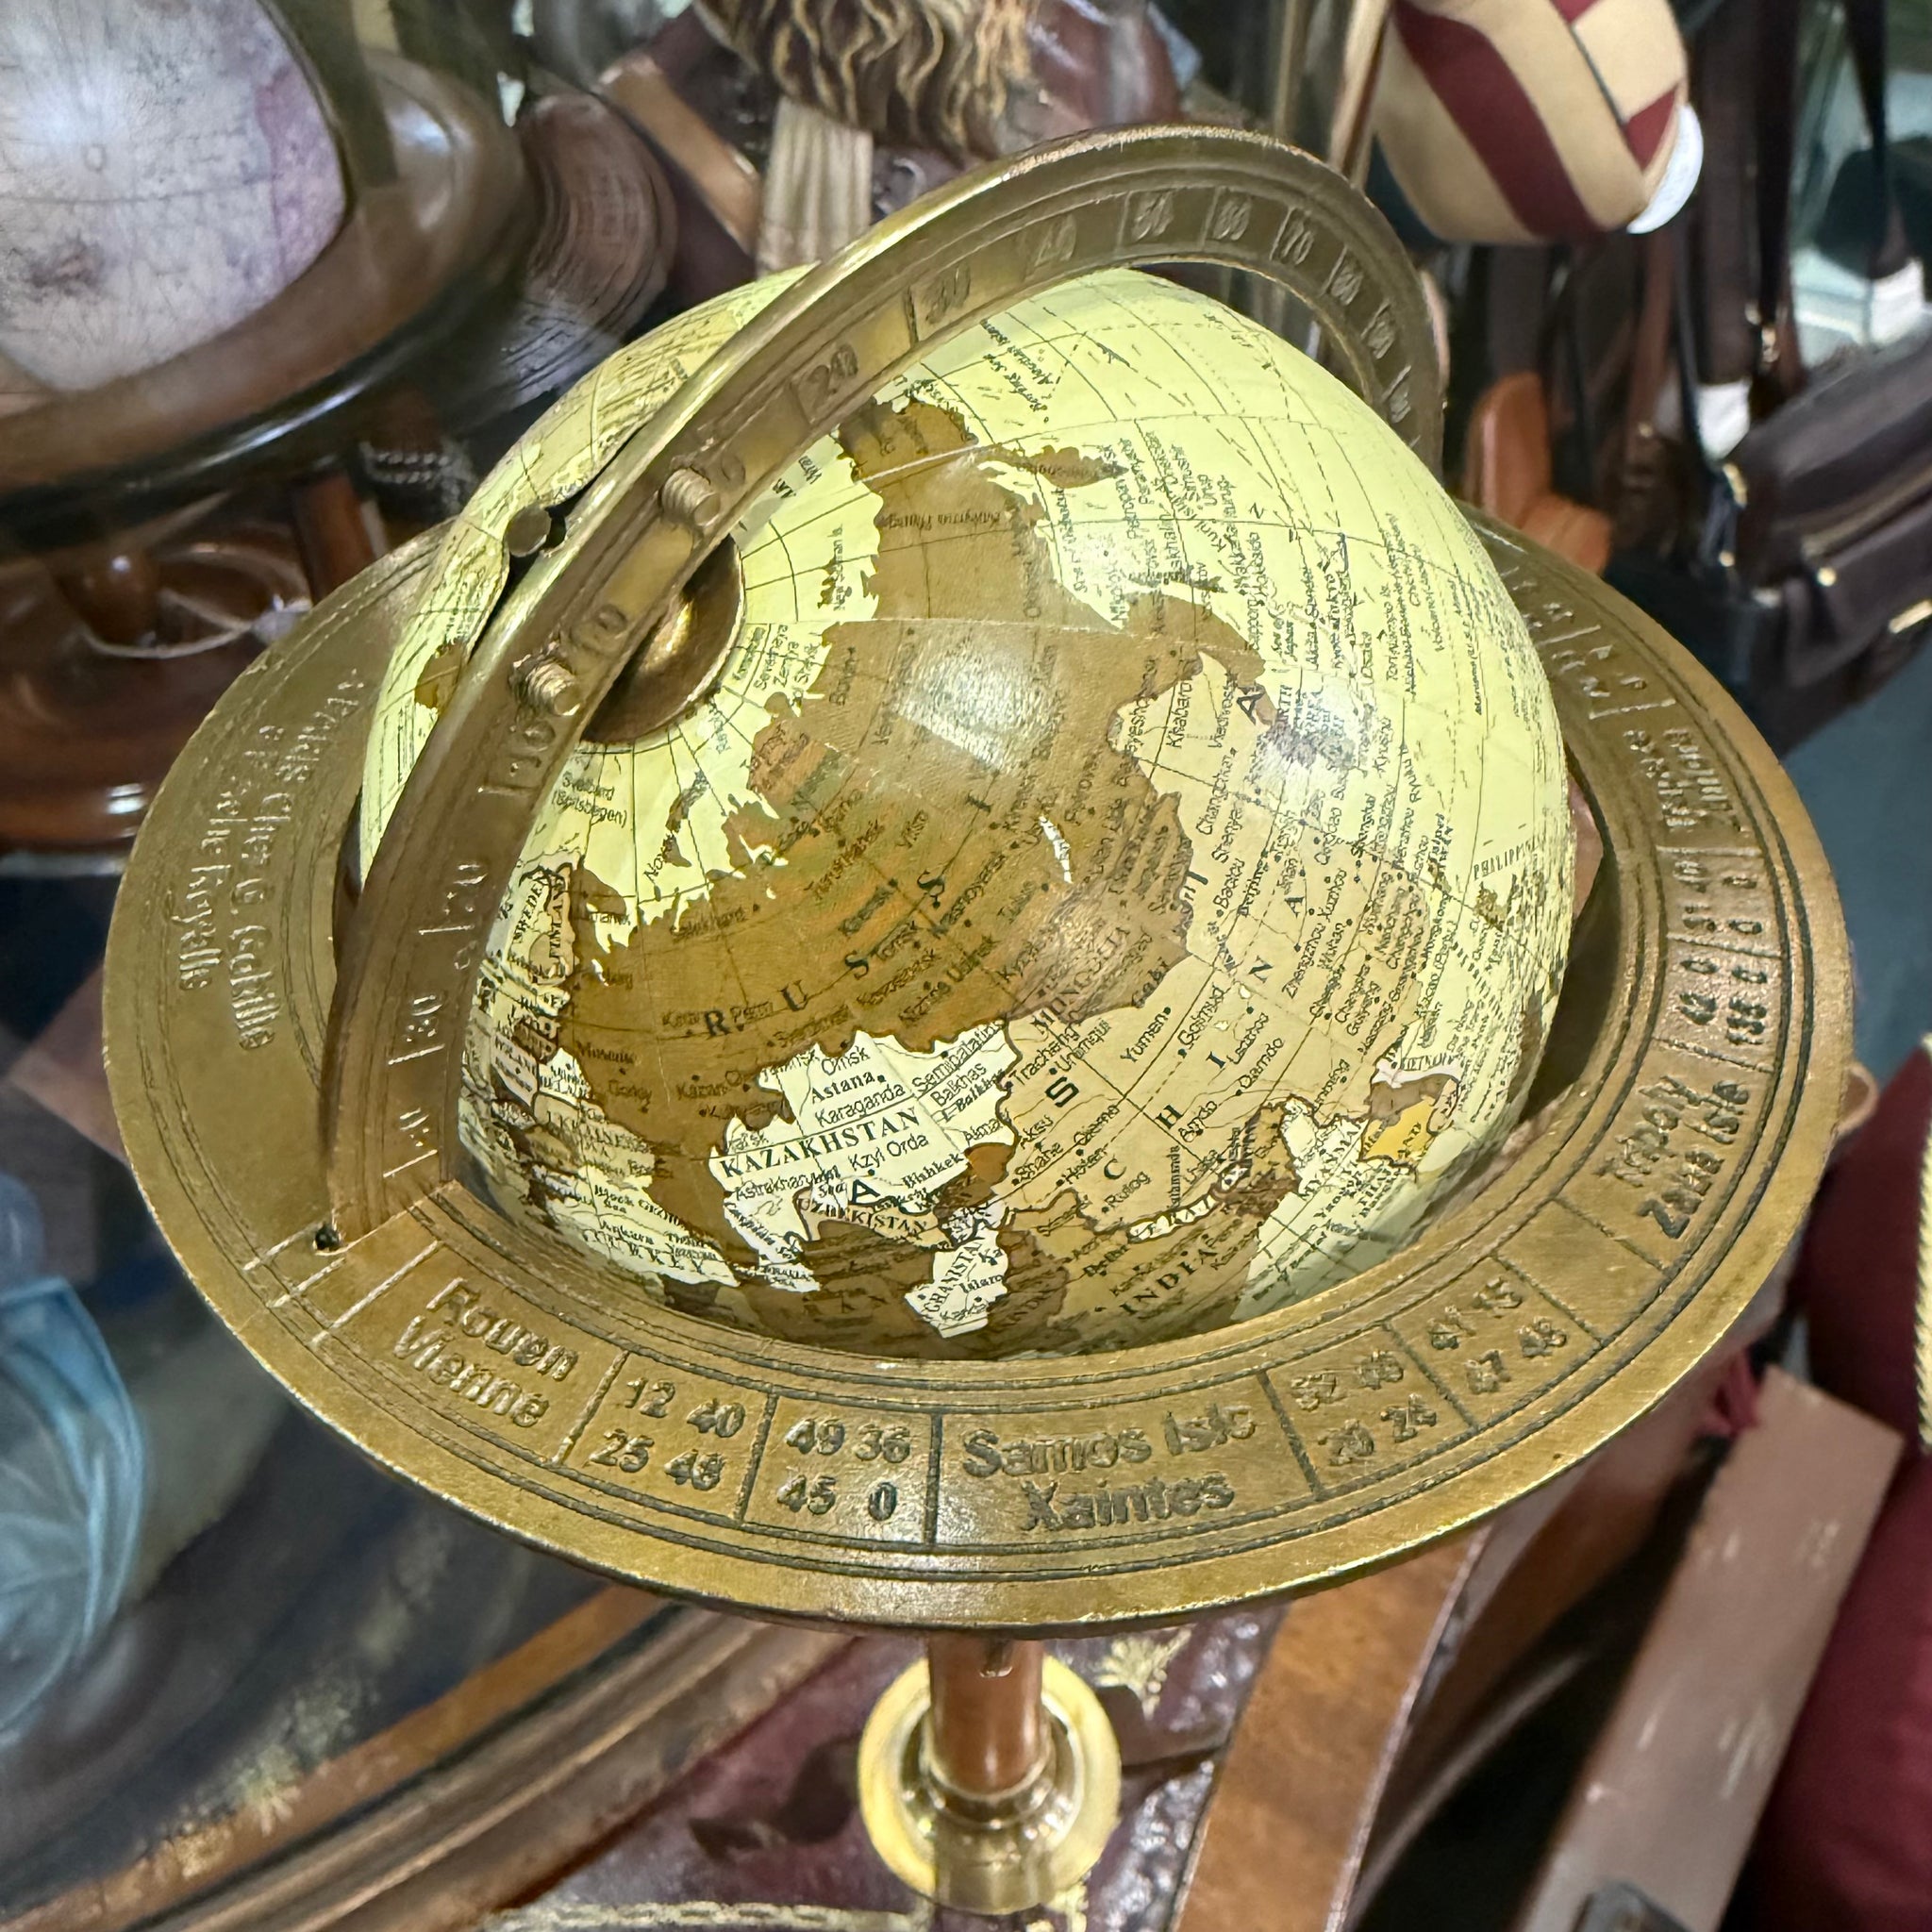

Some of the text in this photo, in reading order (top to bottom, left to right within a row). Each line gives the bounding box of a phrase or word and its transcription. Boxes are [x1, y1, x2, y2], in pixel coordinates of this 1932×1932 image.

[512, 874, 552, 944] SWEDEN
[821, 1045, 872, 1076] Omsk
[1120, 1013, 1167, 1063] Yumen
[810, 1070, 877, 1105] Astana
[815, 1082, 908, 1127] Karaganda
[719, 1107, 923, 1179] KAZAKHSTAN
[887, 1132, 930, 1158] Orda
[1120, 1248, 1219, 1314] INDIA
[425, 1277, 579, 1382] Rouen
[393, 1316, 550, 1428] Vienne
[624, 1377, 746, 1438] 12 40
[590, 1429, 655, 1473] 25
[855, 1423, 911, 1463] 36
[962, 1427, 1152, 1478] Samos
[867, 1481, 897, 1522] 0
[1019, 1472, 1236, 1532] Xaintes
